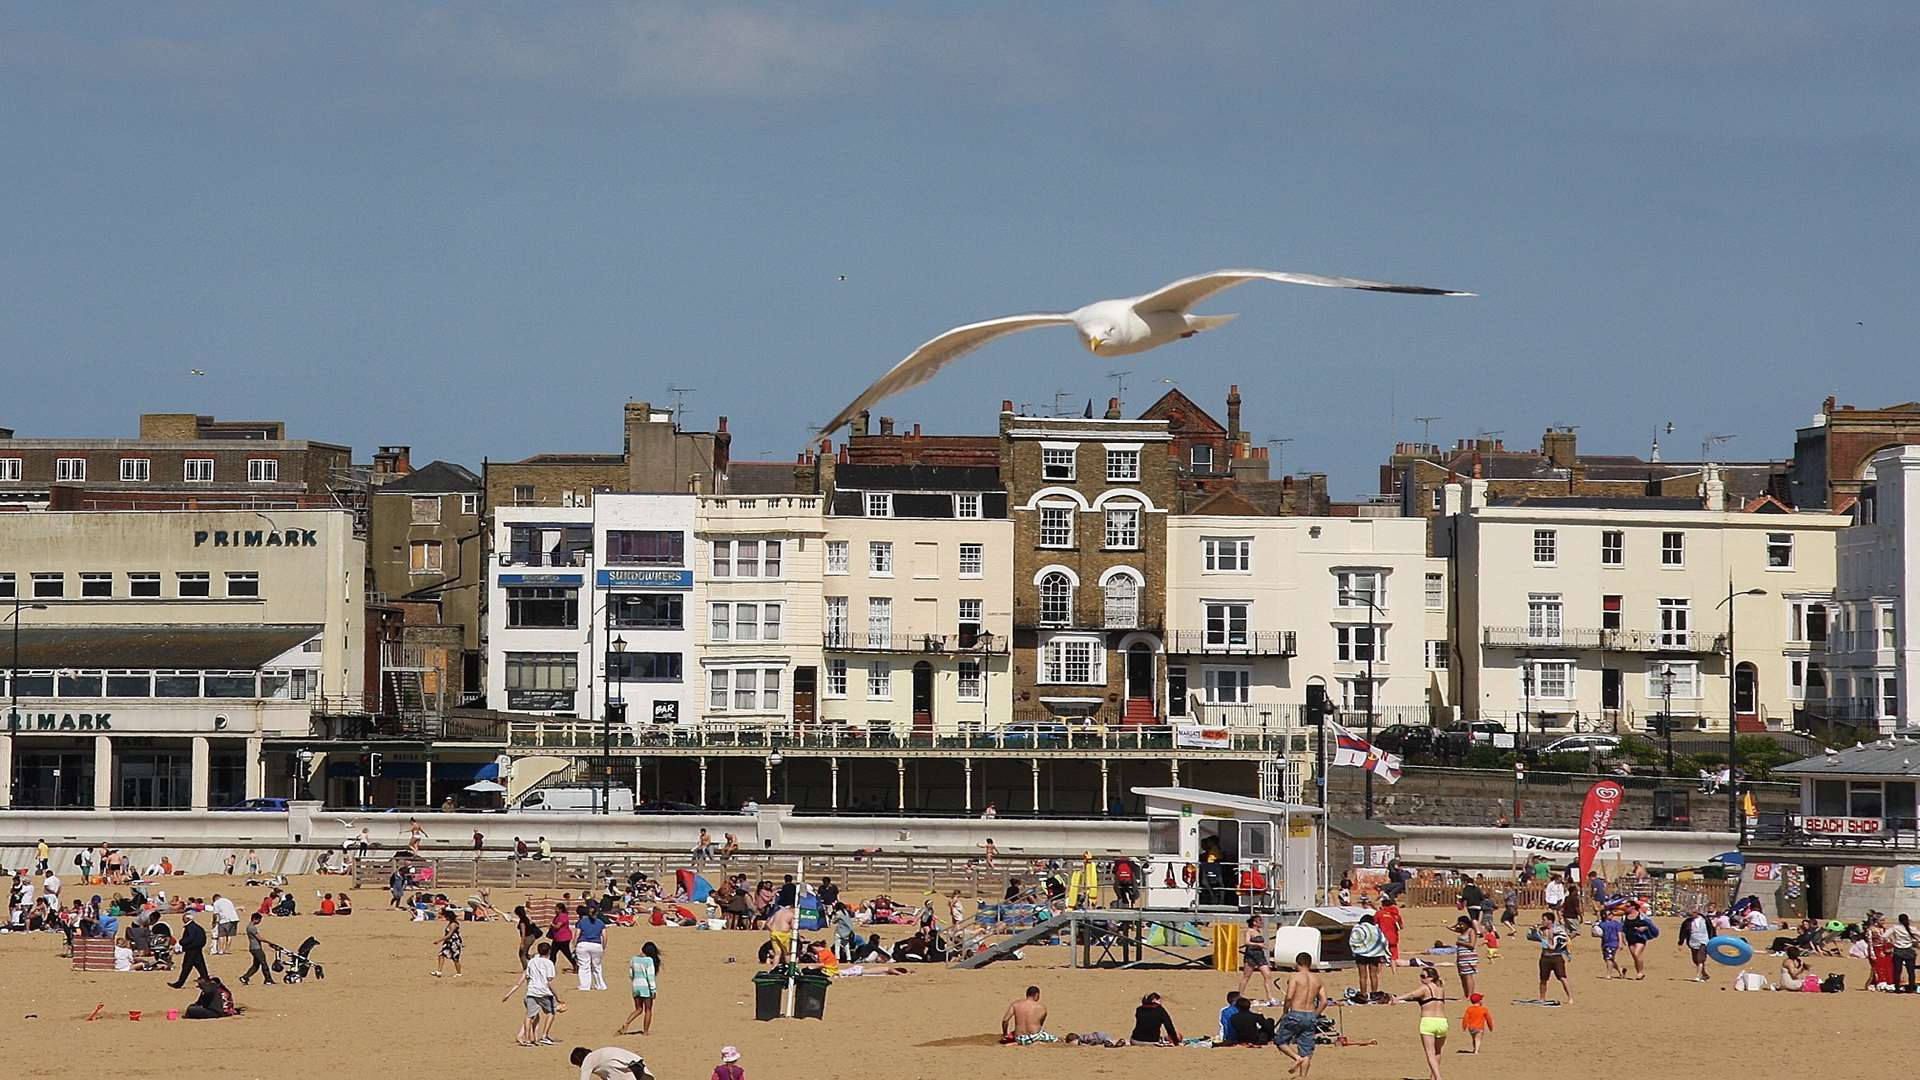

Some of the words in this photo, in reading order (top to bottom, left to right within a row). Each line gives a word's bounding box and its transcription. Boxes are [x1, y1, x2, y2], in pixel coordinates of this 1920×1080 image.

[194, 530, 317, 548] PRIMARK
[655, 704, 675, 715] BAR
[0, 713, 112, 730] RIMARK
[1807, 819, 1843, 833] BEACH
[1848, 820, 1878, 833] SHOP
[1526, 837, 1576, 852] BEACH
